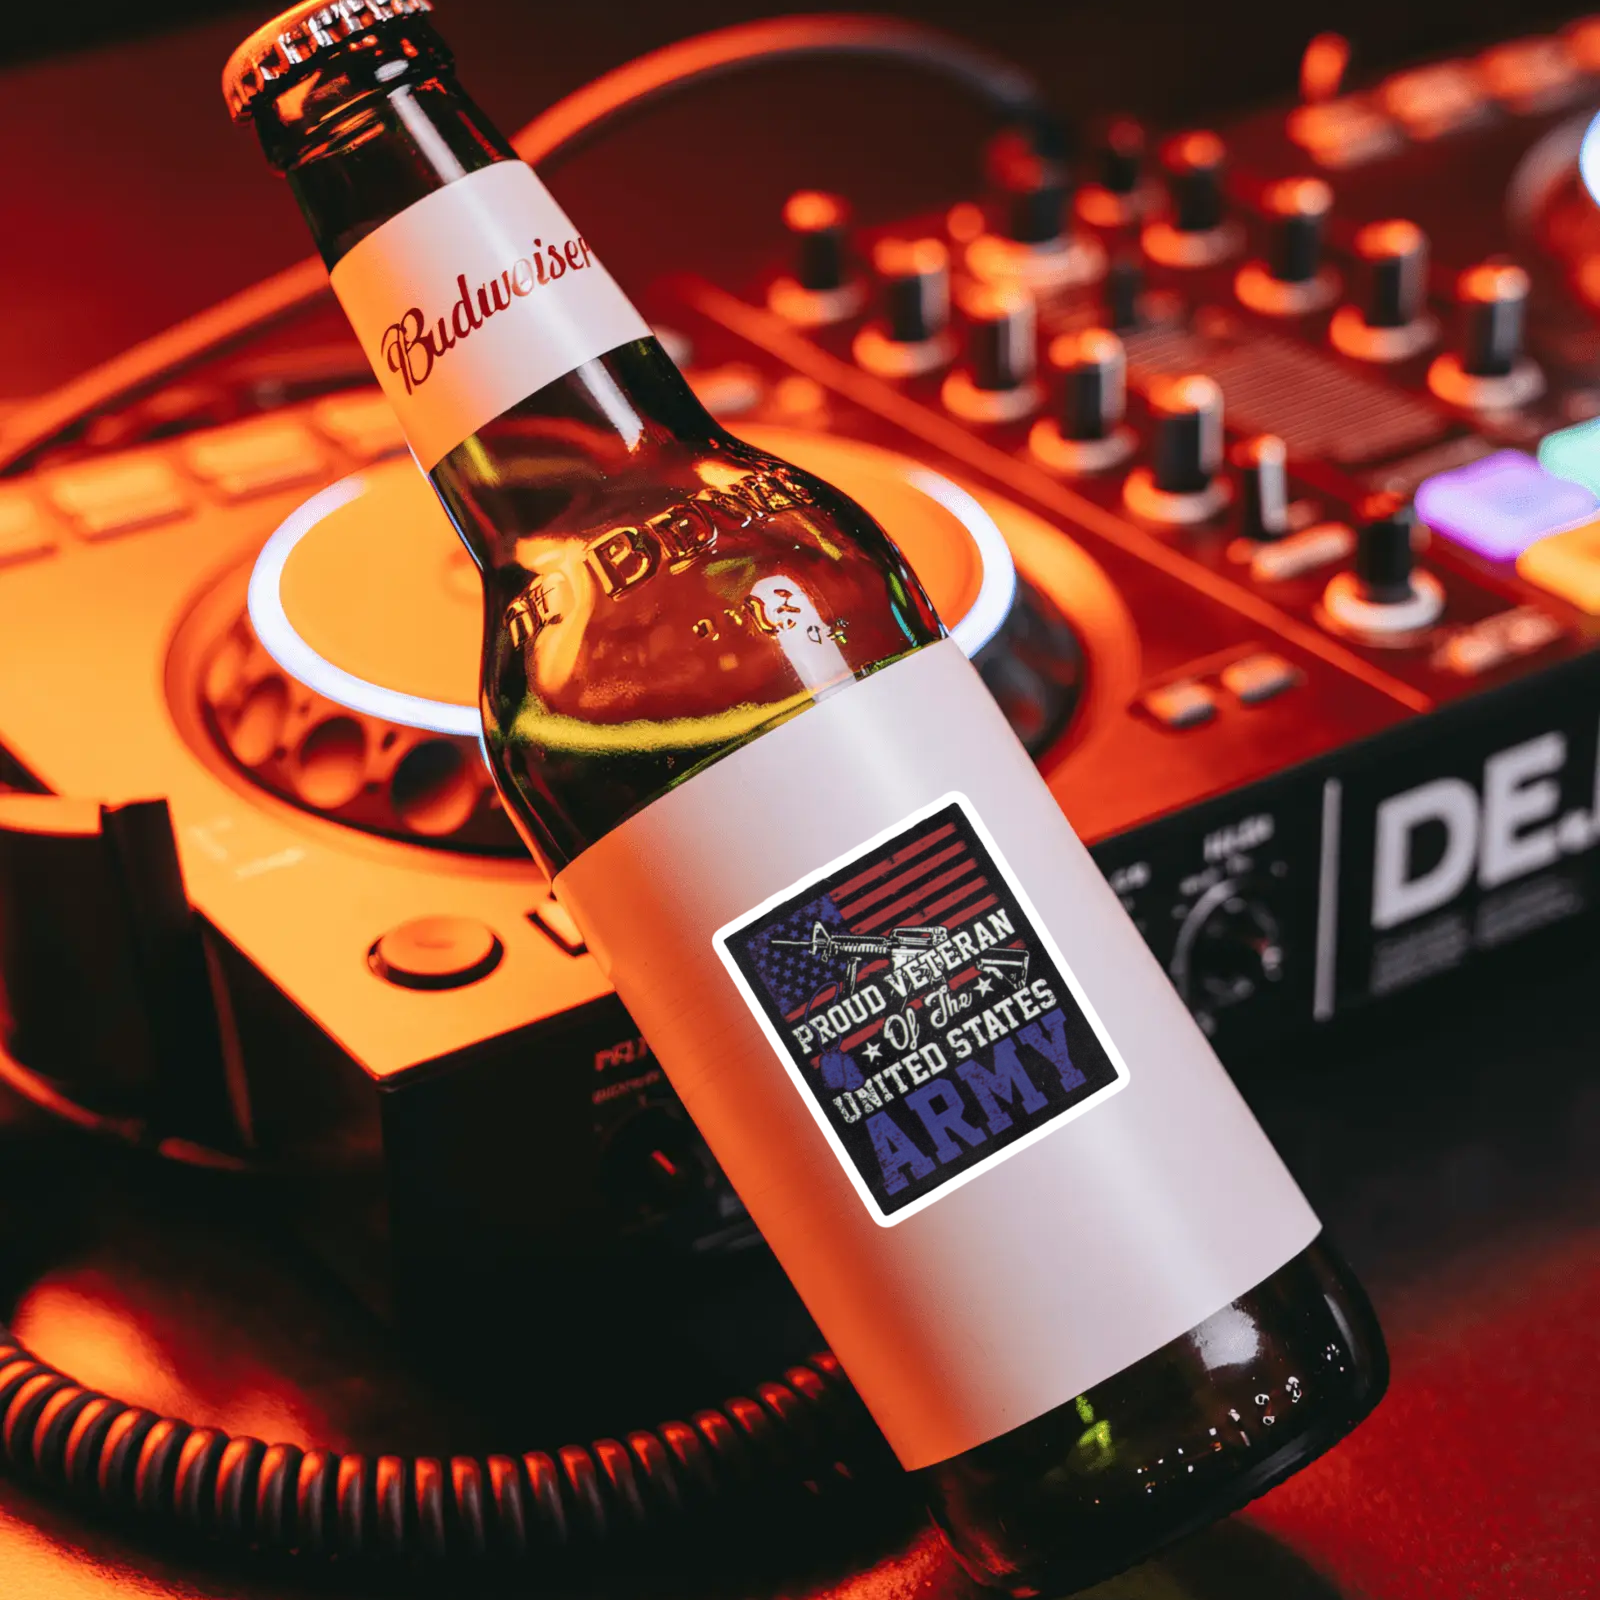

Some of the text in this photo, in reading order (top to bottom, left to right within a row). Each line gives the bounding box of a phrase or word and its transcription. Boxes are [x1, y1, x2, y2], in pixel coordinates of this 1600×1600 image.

[381, 237, 592, 395] Budweiser
[1370, 714, 1600, 930] DE.
[792, 908, 1016, 1054] PROUD VETERAN
[832, 978, 1057, 1123] UNITED STATES
[884, 985, 973, 1051] Of The
[866, 1007, 1087, 1196] ARMY
